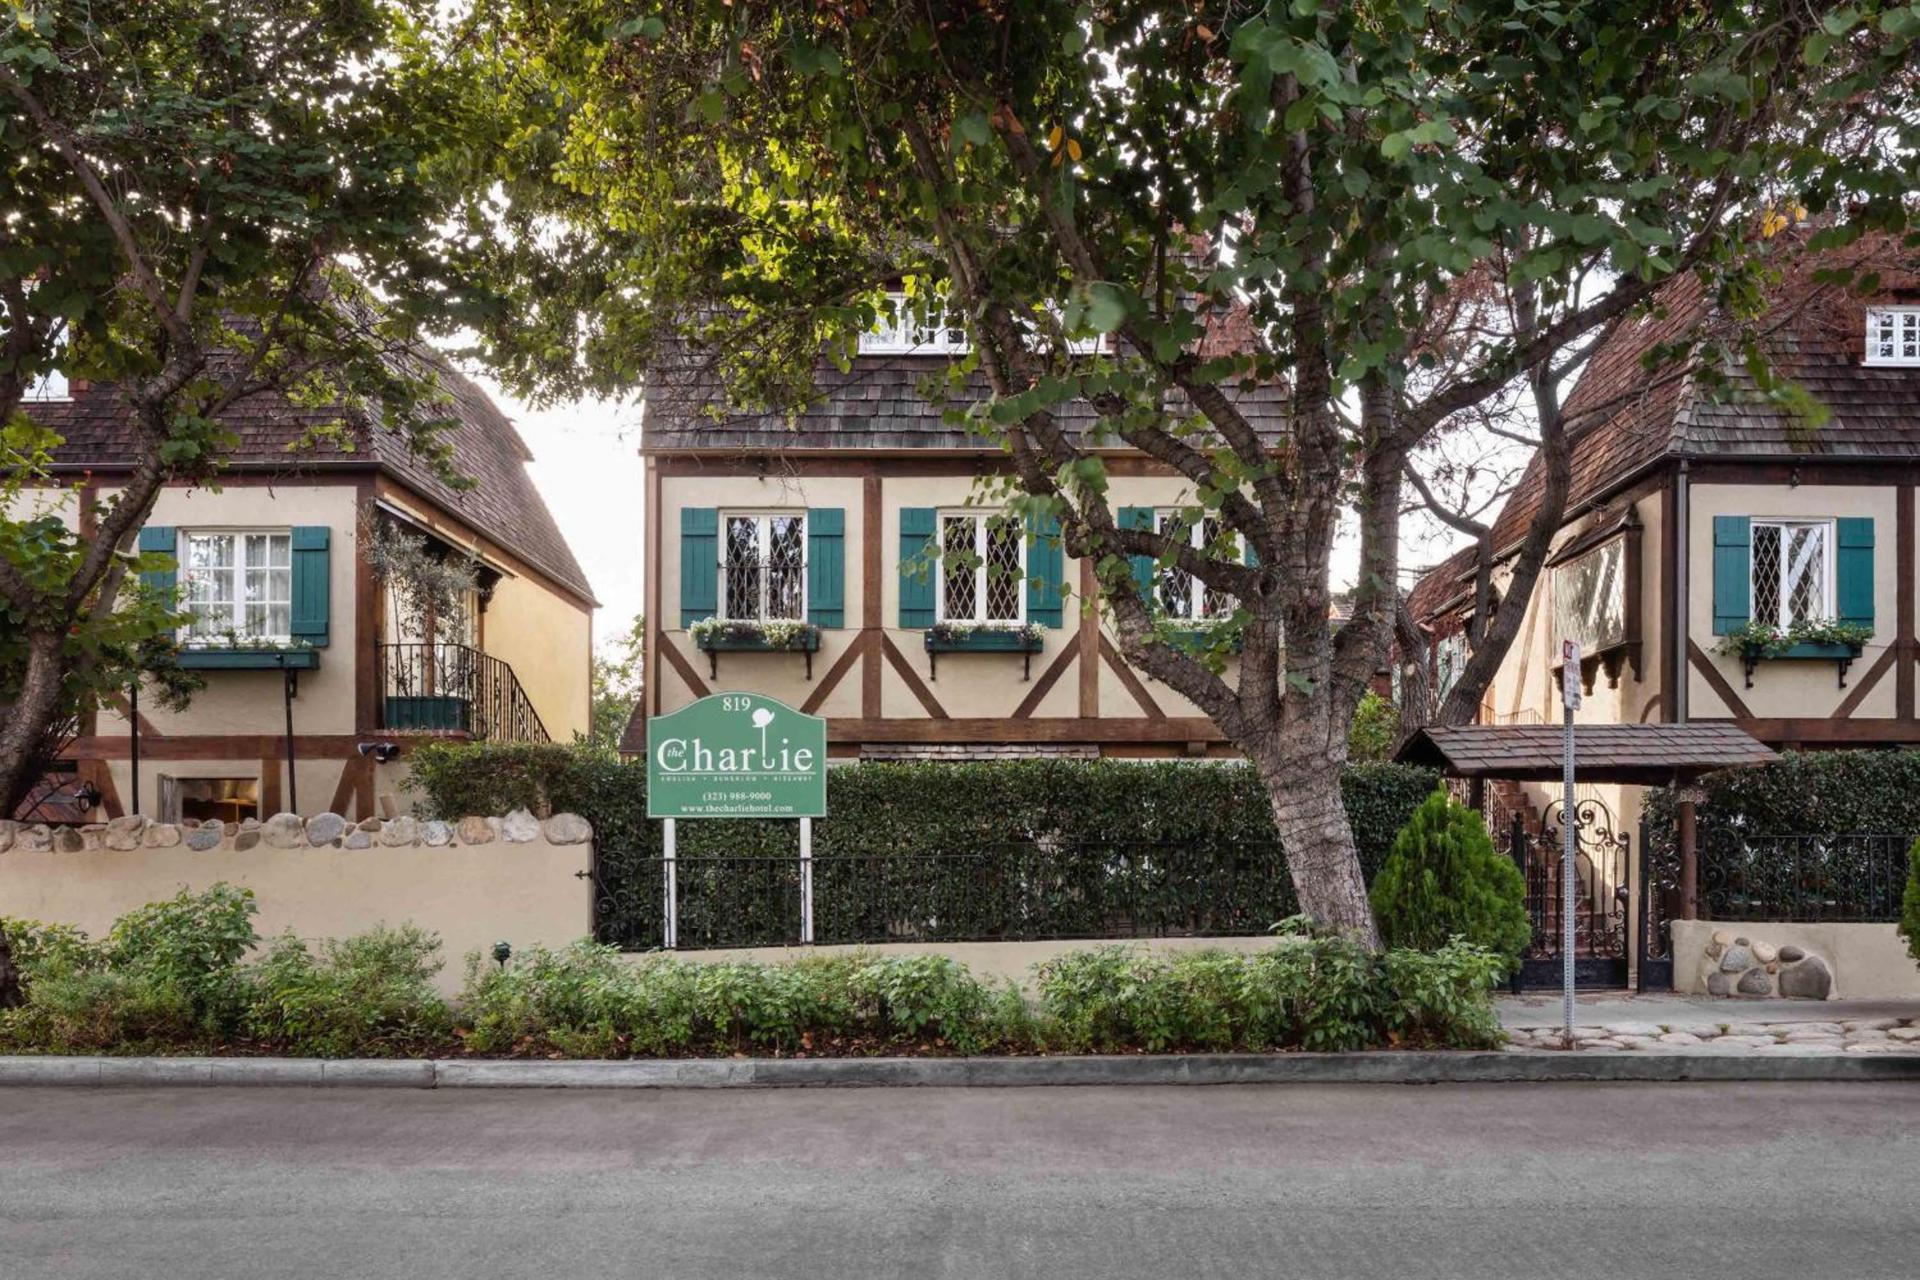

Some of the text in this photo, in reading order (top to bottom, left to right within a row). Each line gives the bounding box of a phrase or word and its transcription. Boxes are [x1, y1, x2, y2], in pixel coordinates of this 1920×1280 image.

[722, 696, 751, 711] 819
[657, 726, 813, 771] the Charlie
[729, 791, 772, 800] 988-9000
[681, 804, 793, 812] www.thecharliehotel.com
